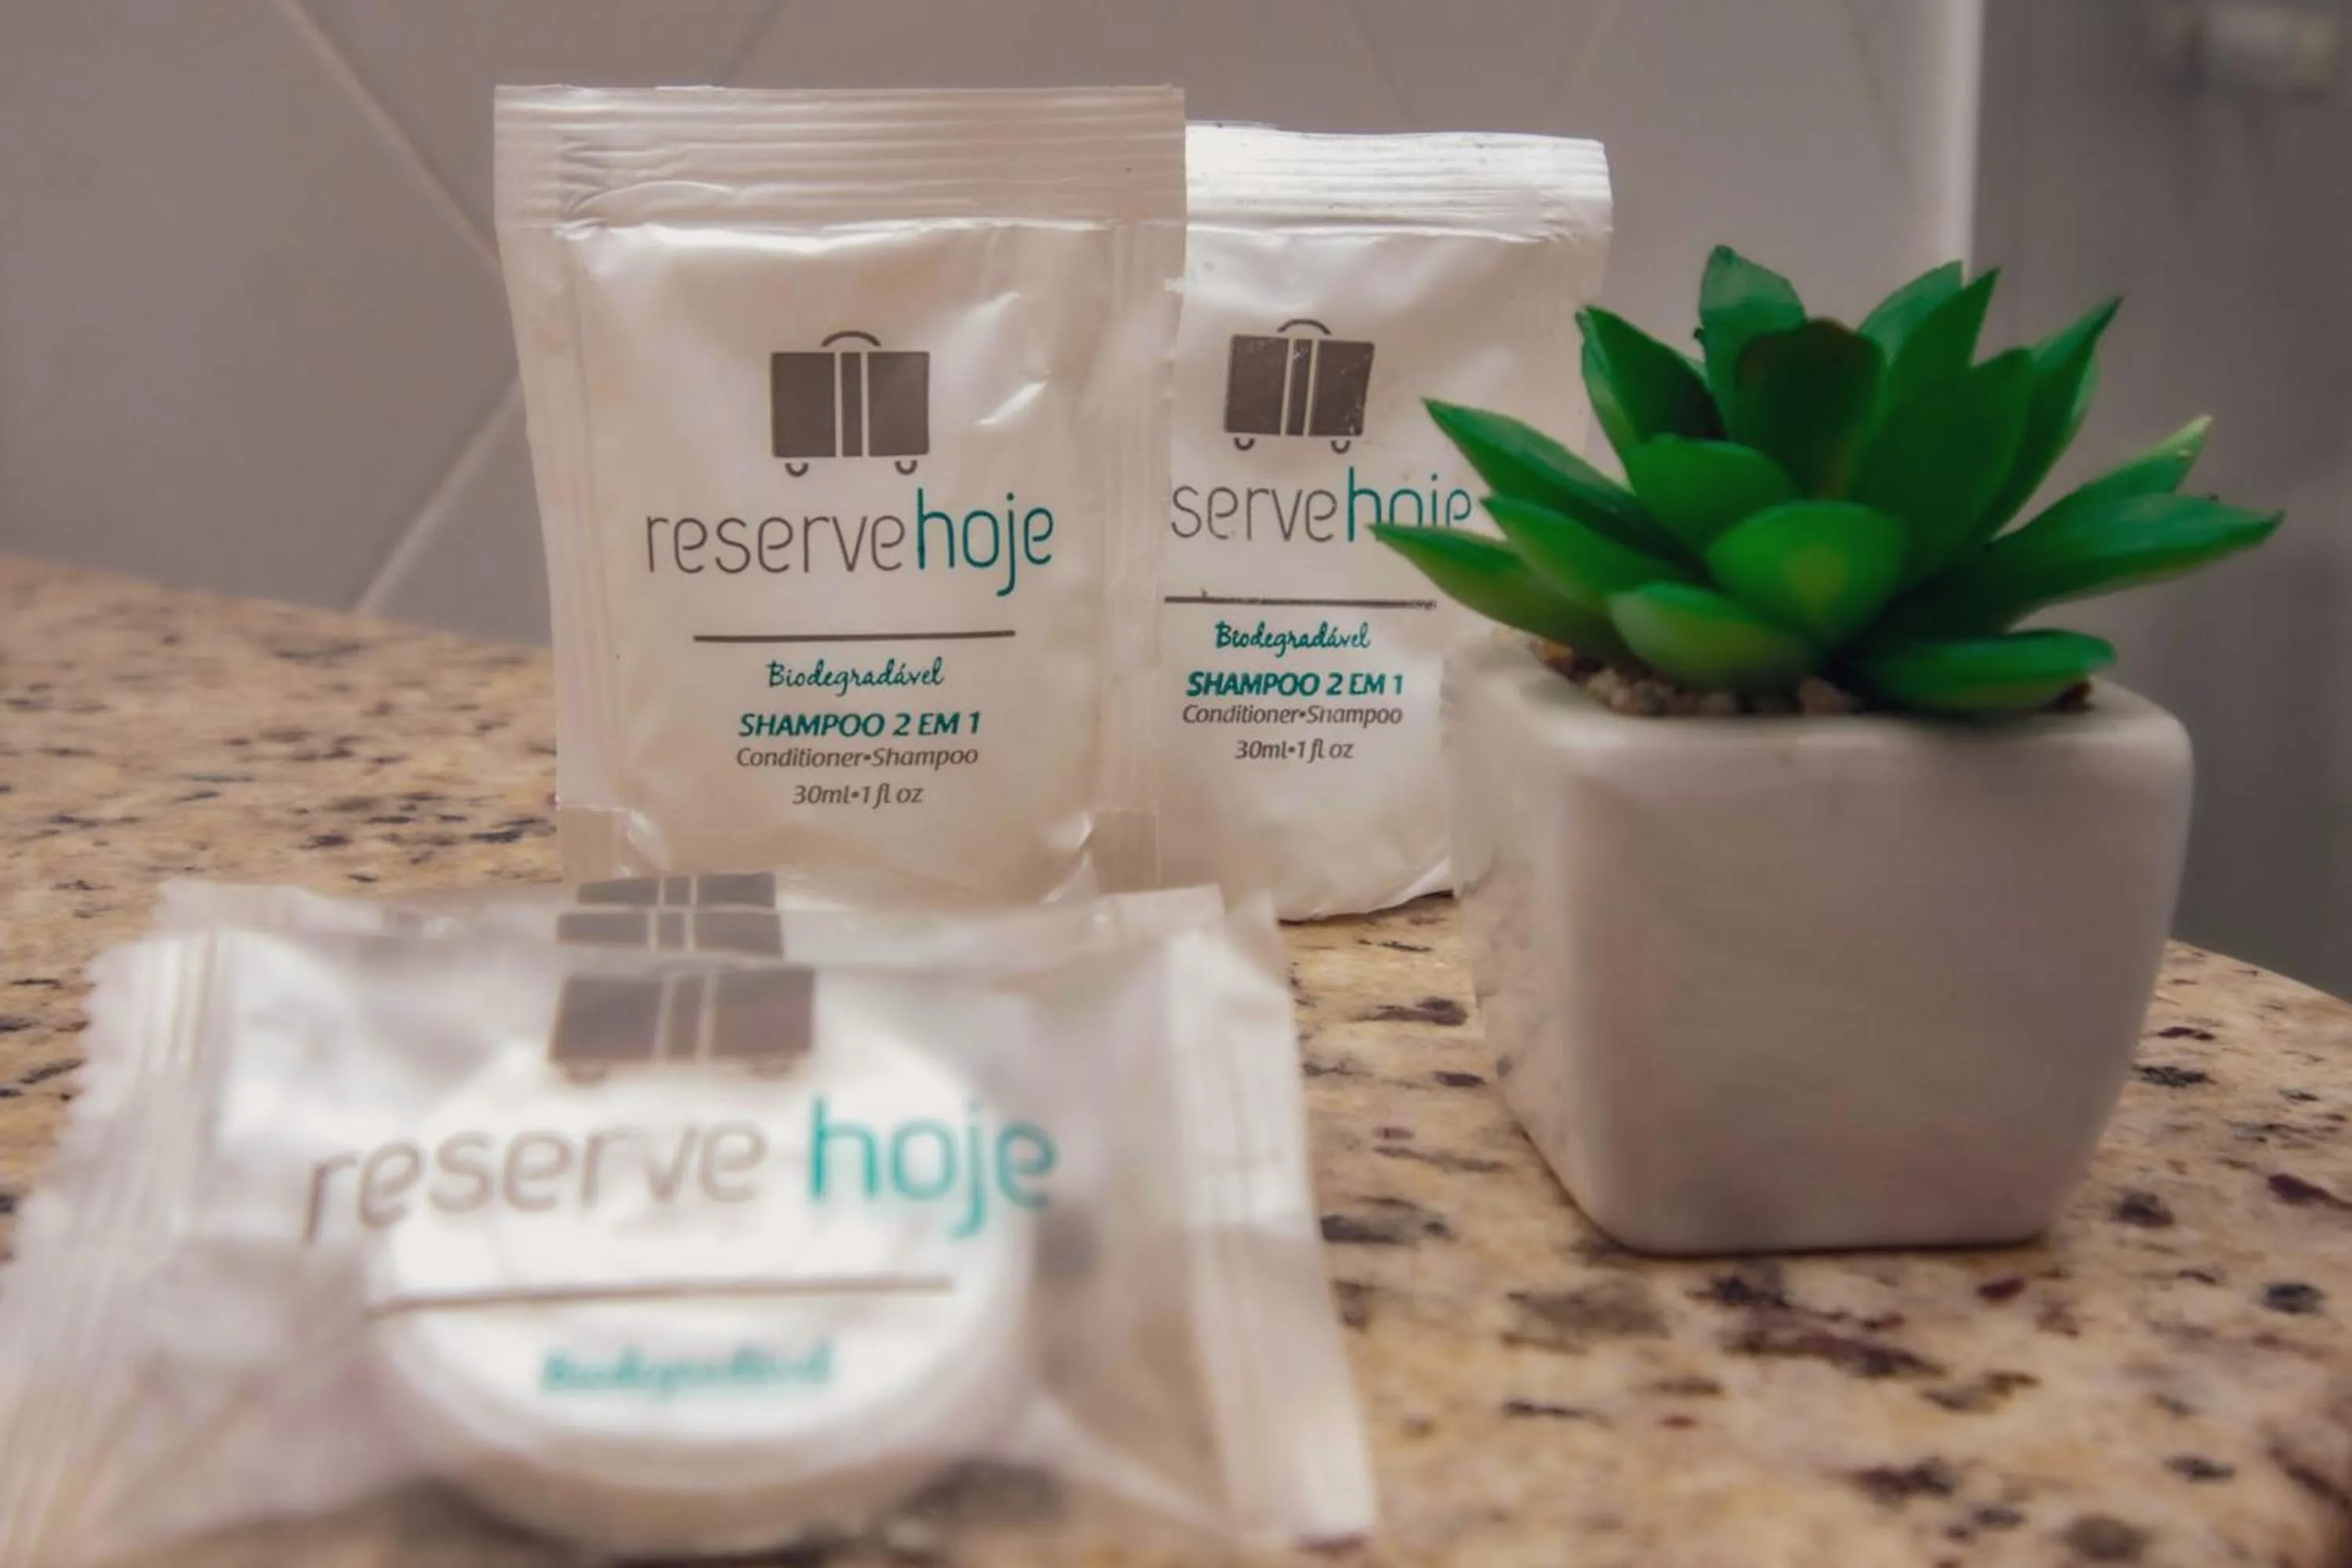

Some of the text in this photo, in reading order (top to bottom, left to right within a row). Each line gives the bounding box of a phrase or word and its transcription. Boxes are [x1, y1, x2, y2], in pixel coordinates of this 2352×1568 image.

[1214, 619, 1370, 659] Biodegradável
[766, 656, 945, 697] Biodegradável
[1185, 670, 1403, 697] SHAMPOO 2 EM 1
[738, 711, 980, 737] SHAMPOO 2 EM 1
[1329, 744, 1355, 759] oz
[896, 787, 924, 804] oz
[303, 1094, 1058, 1247] reserve hoje
